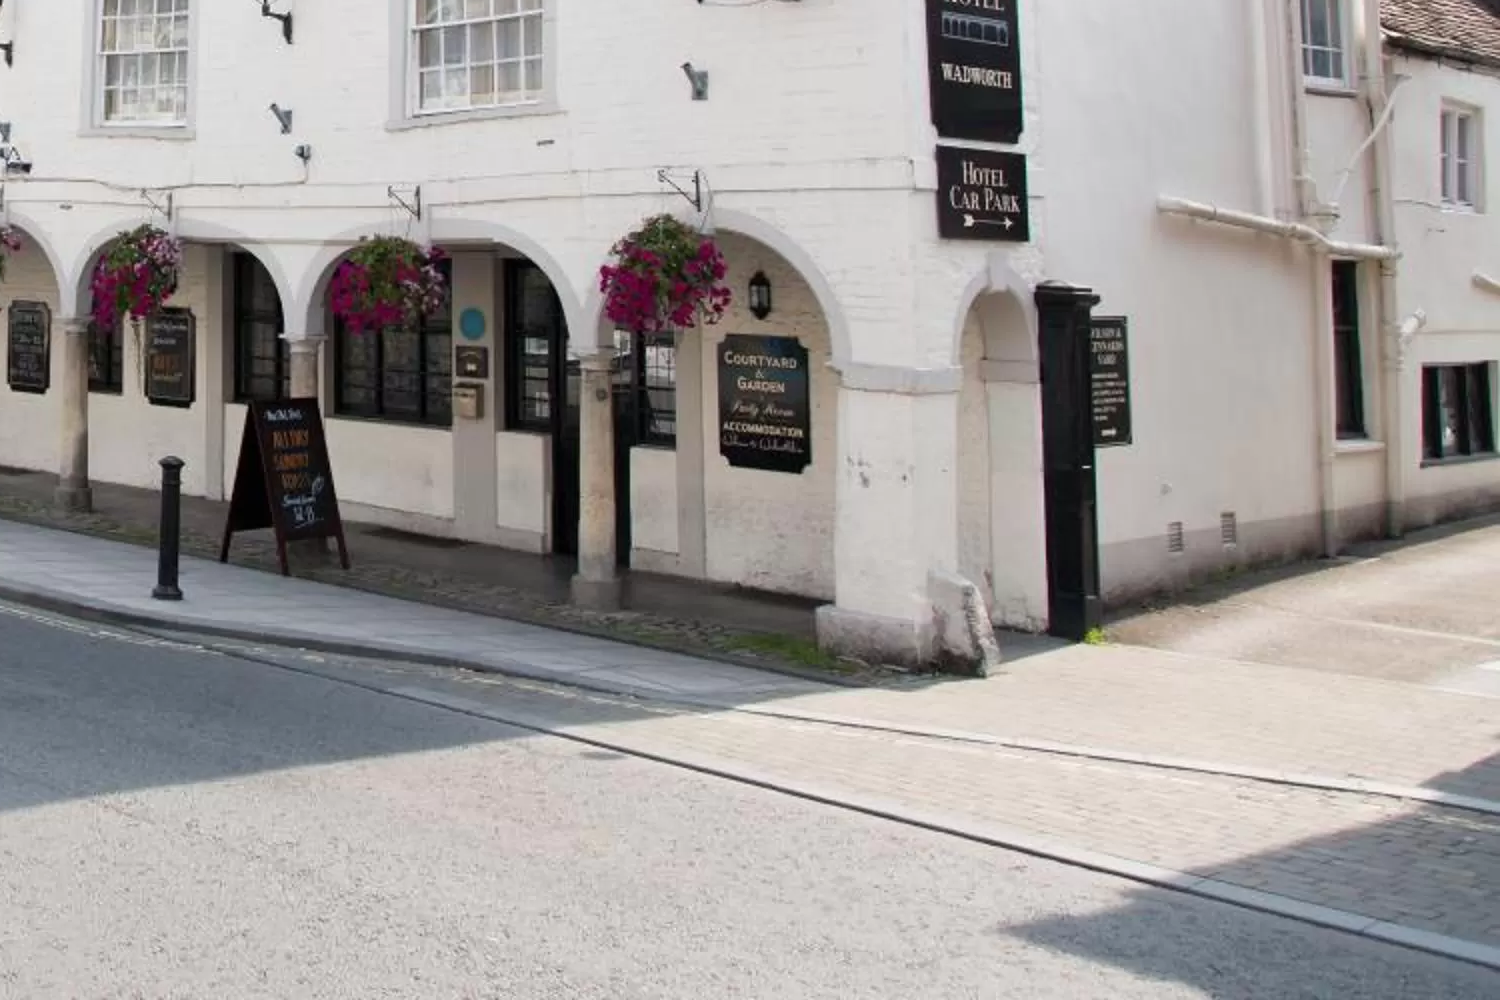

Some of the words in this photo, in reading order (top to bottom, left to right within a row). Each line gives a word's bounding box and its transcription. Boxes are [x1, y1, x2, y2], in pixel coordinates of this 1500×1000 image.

[941, 62, 1012, 89] WADWORTH
[963, 161, 1008, 187] HOTEL
[949, 184, 980, 210] CAR
[984, 187, 1020, 213] PARK
[724, 351, 797, 369] COURTYARD
[737, 375, 785, 393] GARDEN
[723, 421, 804, 438] ACCOMMODATION
